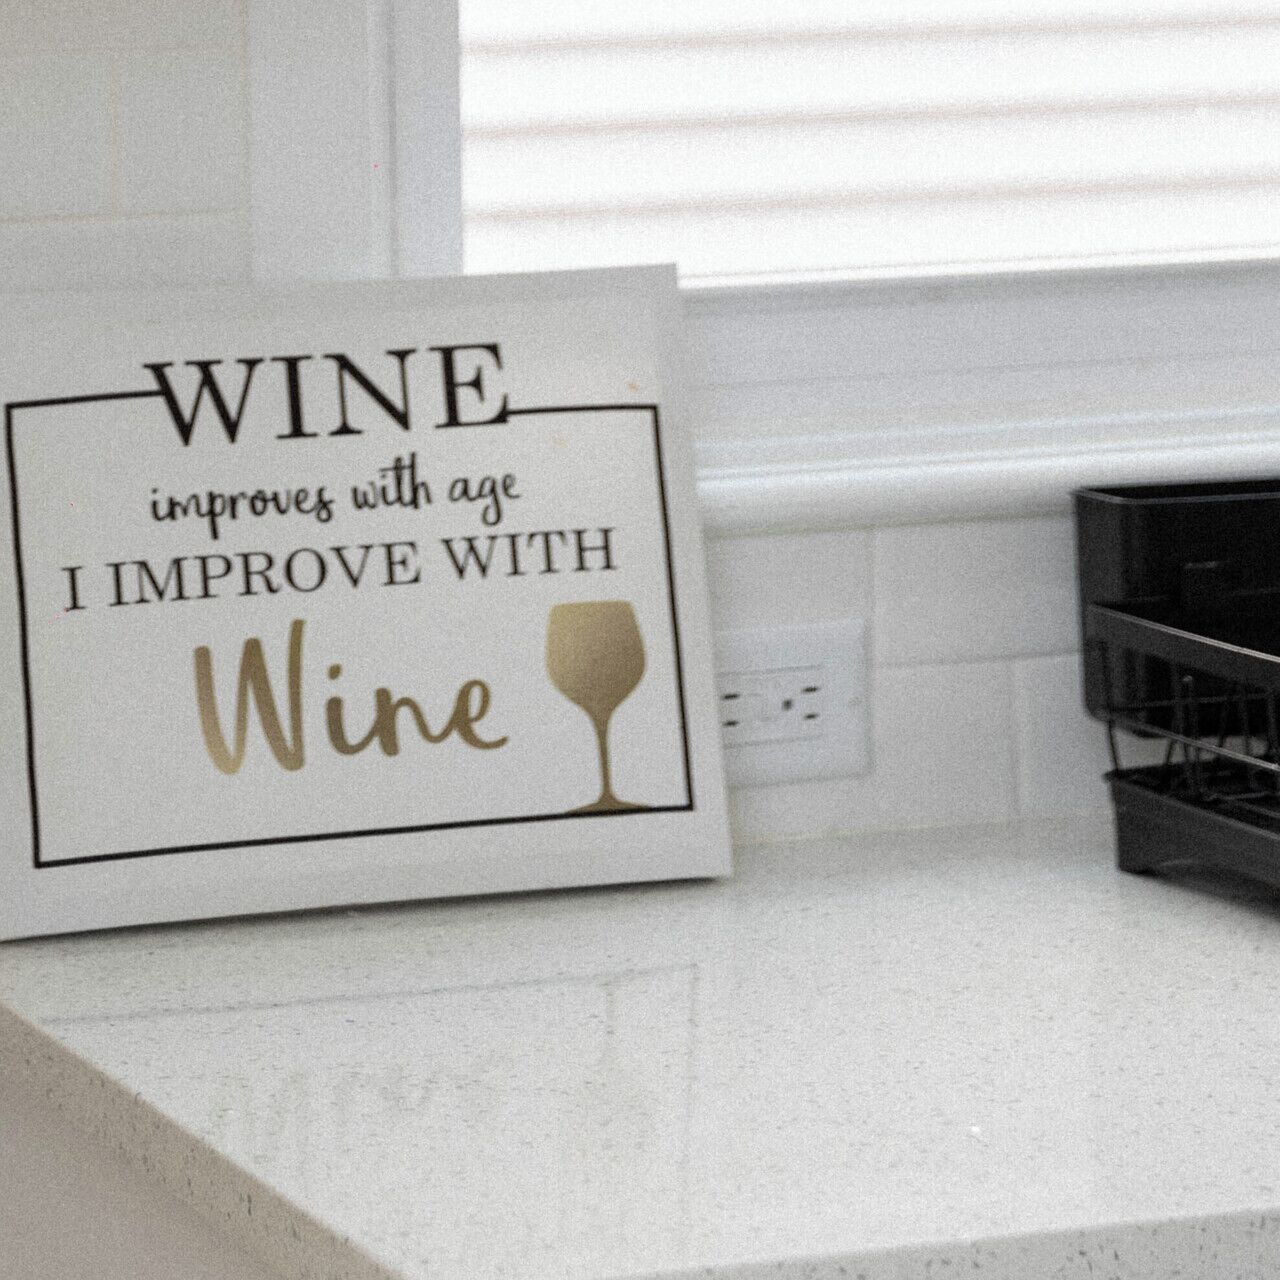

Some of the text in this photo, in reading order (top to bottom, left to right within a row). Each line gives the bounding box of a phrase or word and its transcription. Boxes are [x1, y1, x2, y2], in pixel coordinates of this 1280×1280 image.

[143, 342, 510, 447] WINE
[150, 452, 520, 541] improves with age
[62, 527, 619, 612] I IMPROVE WITH
[194, 619, 509, 775] Wine
